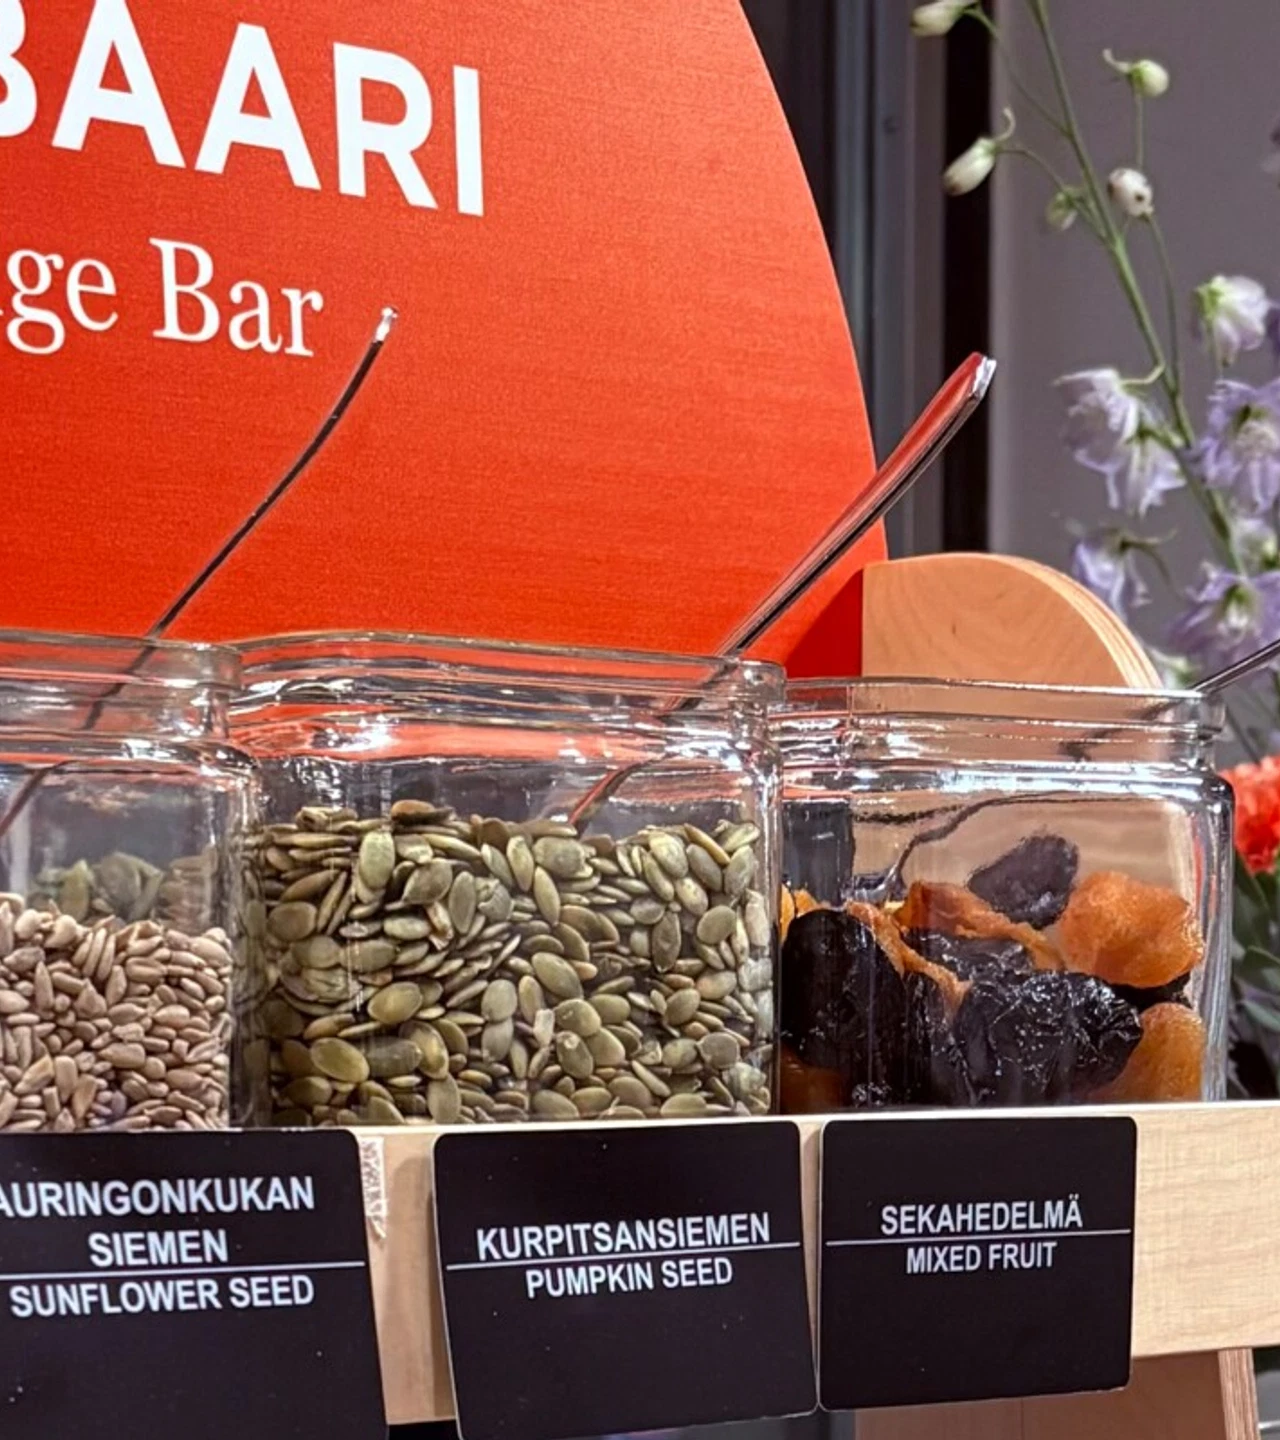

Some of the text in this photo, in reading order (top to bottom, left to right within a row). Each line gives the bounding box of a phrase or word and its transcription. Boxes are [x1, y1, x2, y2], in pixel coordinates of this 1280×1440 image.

[148, 236, 324, 357] Bar
[880, 1193, 1083, 1235] SEKAHEDELMÄ
[88, 1229, 228, 1267] SIEMEN
[476, 1212, 771, 1261] KURPITSANSIEMEN
[906, 1241, 1058, 1274] MIXED FRUIT
[10, 1275, 315, 1318] SUNFLOWER SEED
[526, 1257, 733, 1299] PUMPKIN SEED
